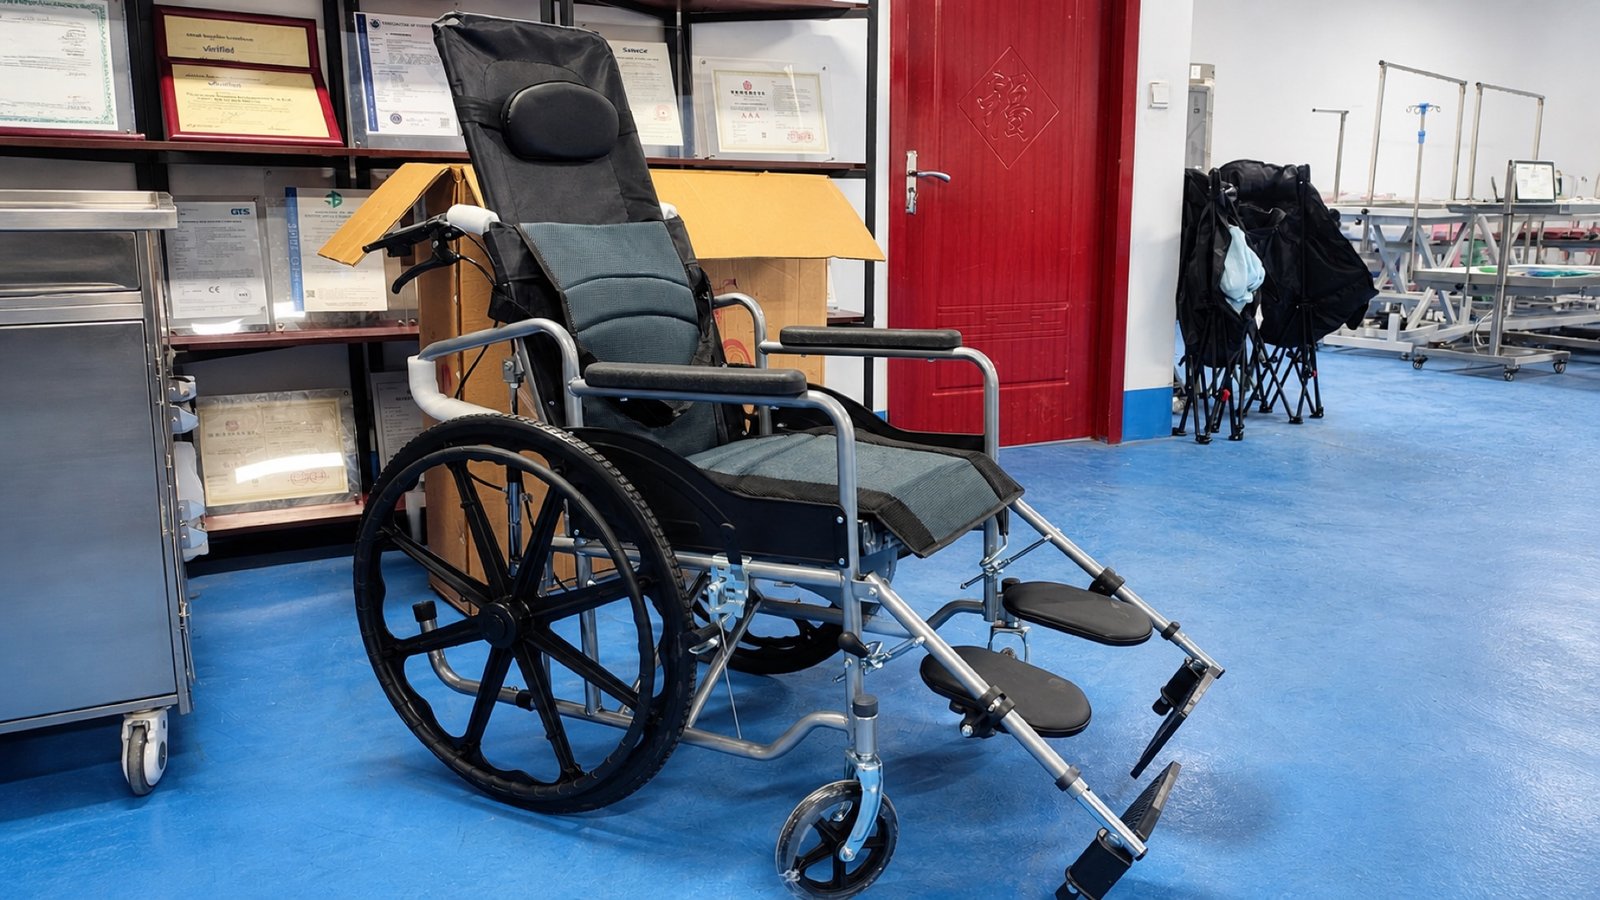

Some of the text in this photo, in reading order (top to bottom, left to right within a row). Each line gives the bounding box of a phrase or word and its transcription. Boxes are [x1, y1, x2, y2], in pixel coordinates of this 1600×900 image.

[203, 44, 235, 54] Verified
[230, 207, 251, 216] GTS
[208, 285, 220, 294] CE
